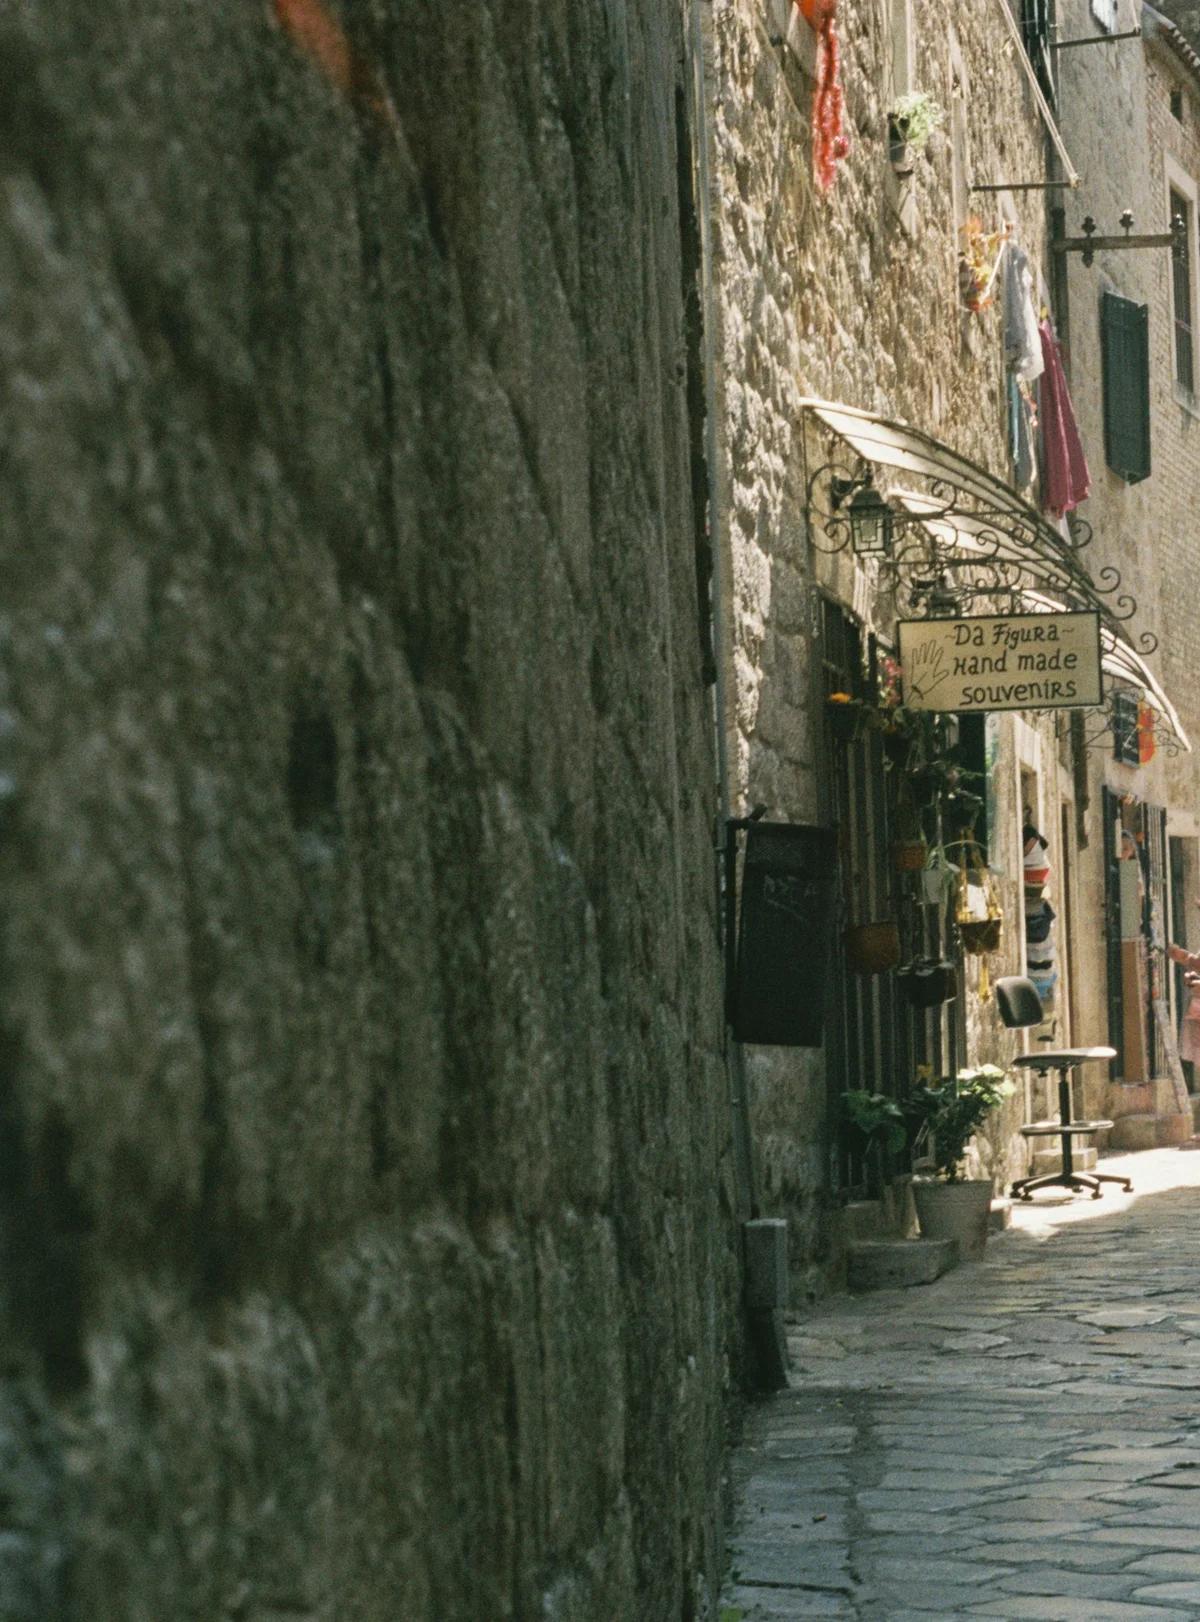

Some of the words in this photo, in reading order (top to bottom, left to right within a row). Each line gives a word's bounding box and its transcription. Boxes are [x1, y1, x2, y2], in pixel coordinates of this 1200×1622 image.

[954, 624, 984, 646] Da
[953, 650, 1008, 676] Hand
[1018, 647, 1078, 672] made
